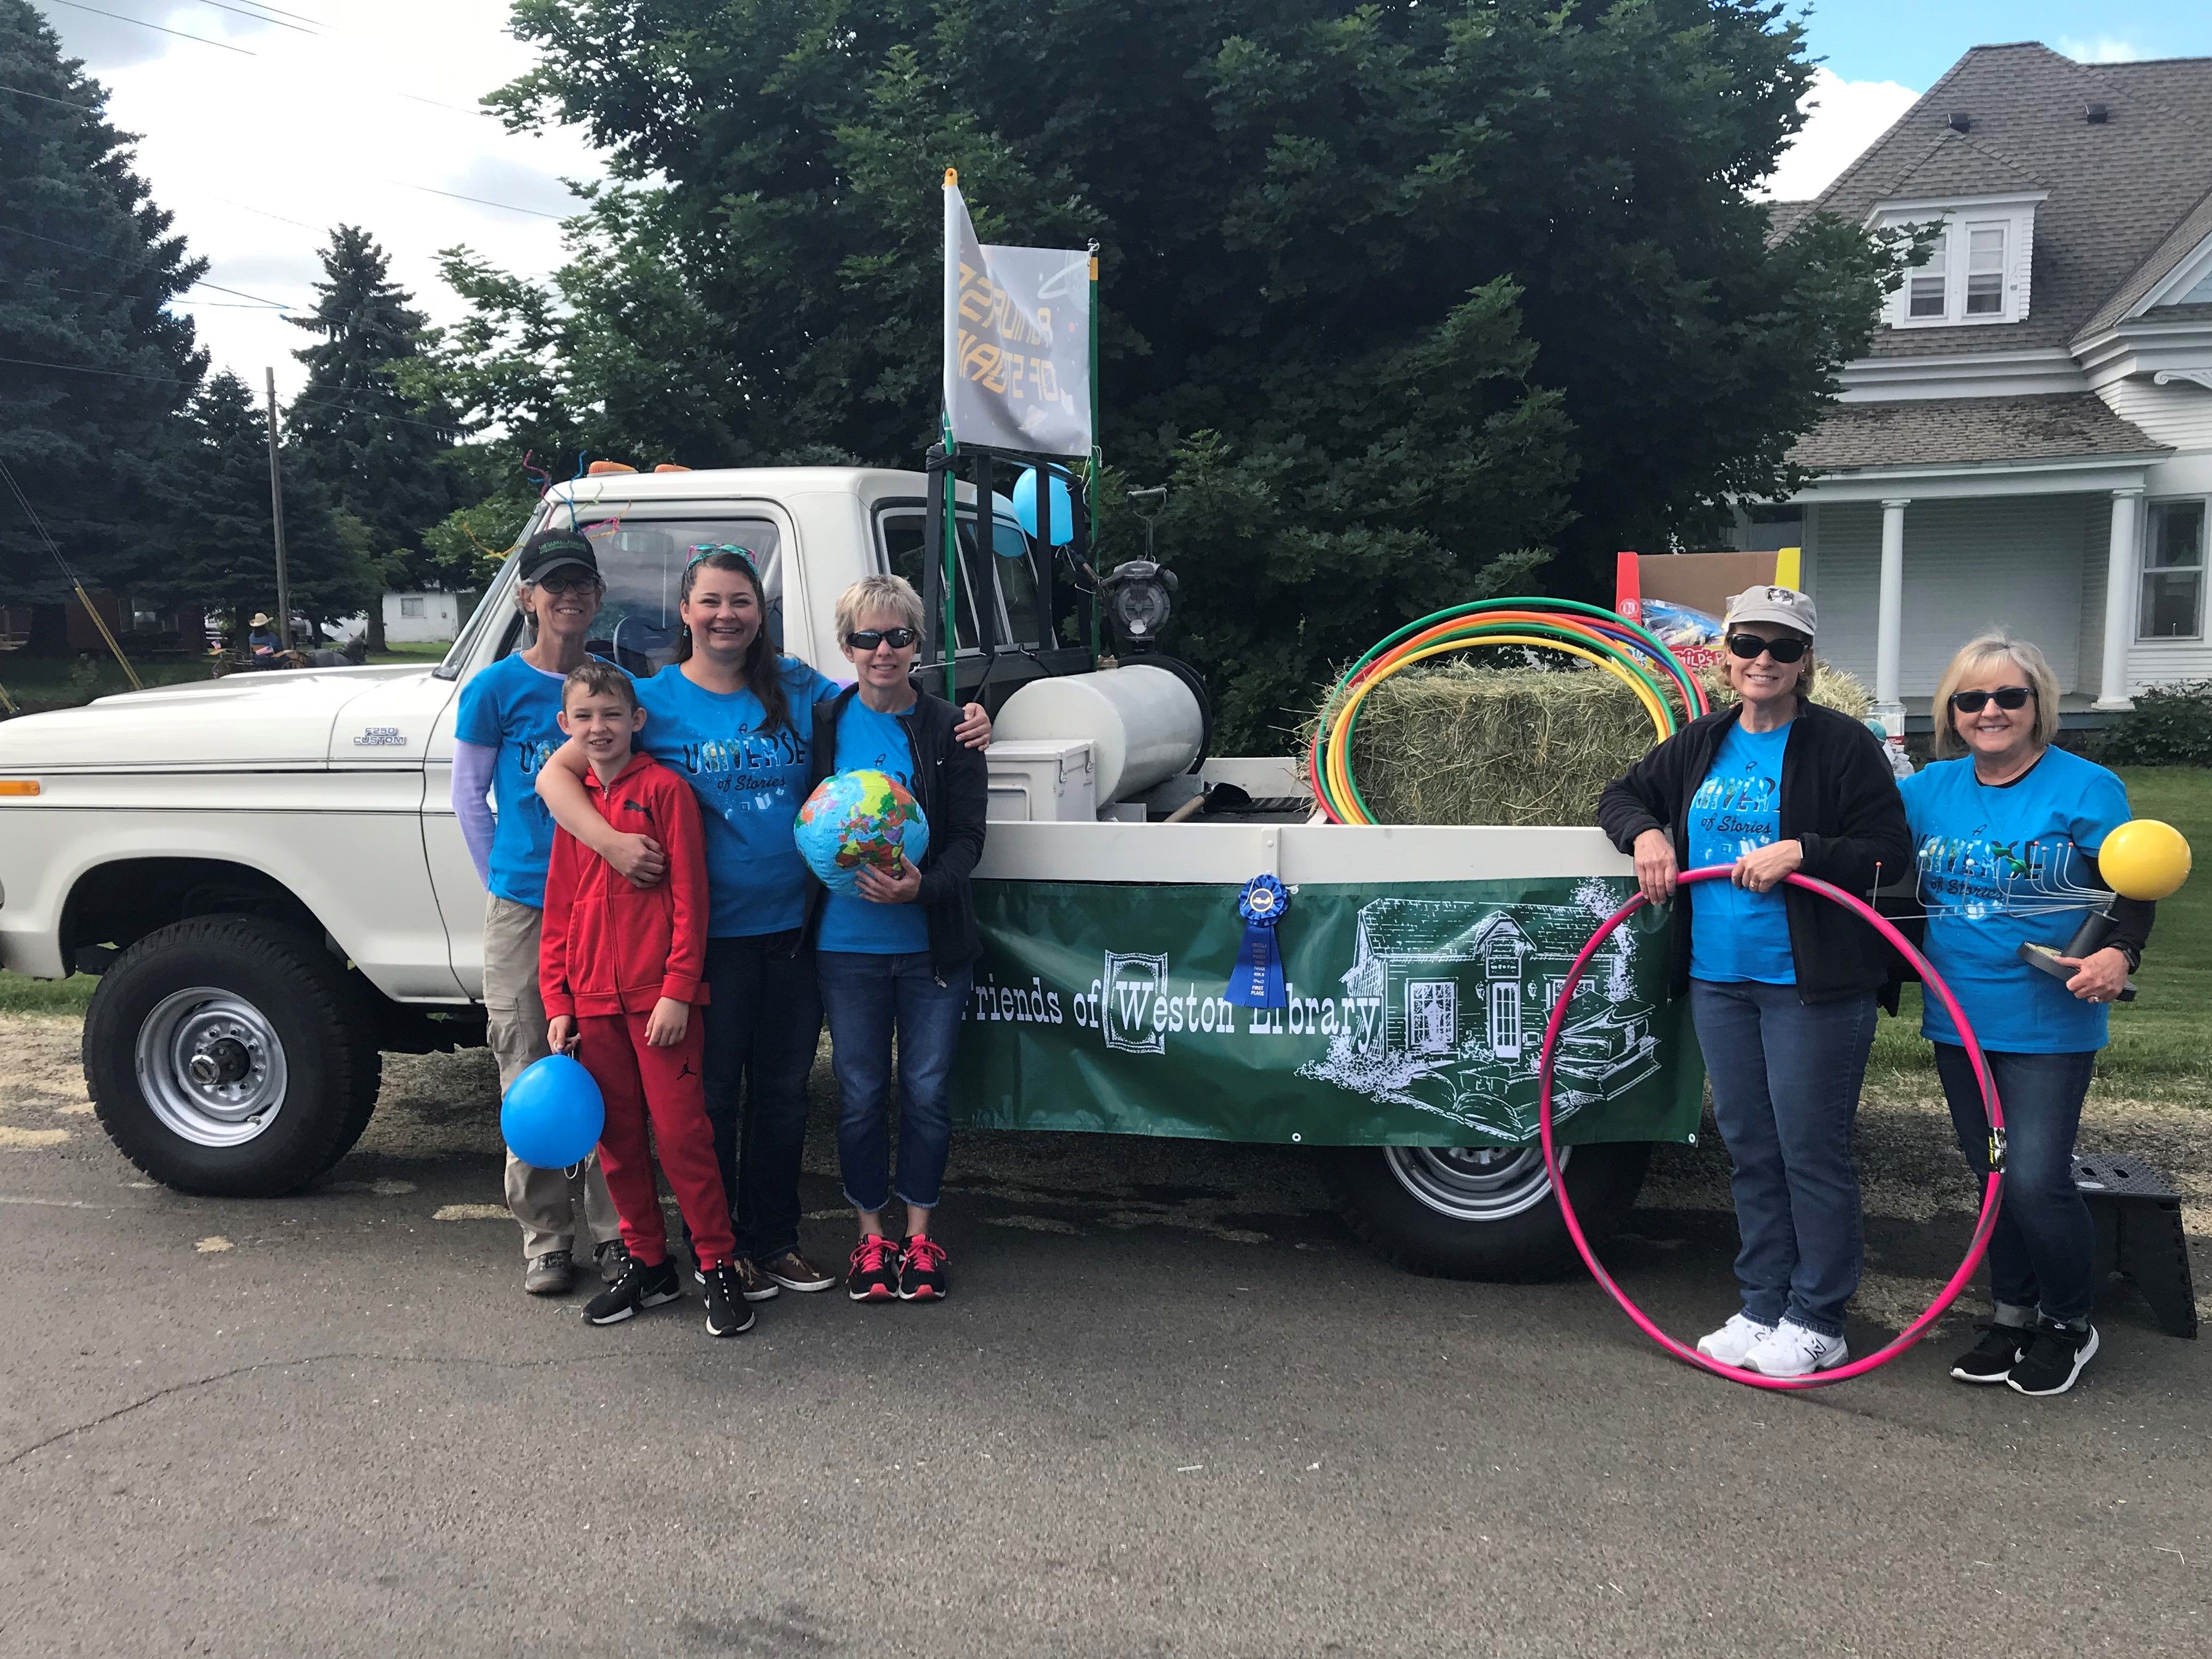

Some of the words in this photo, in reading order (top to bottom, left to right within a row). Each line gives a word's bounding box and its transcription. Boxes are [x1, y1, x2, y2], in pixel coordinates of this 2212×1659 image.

[353, 736, 405, 745] CUSTOM
[682, 731, 806, 776] UNIVERSE
[717, 774, 732, 793] of
[735, 774, 786, 791] Stories
[1701, 813, 1718, 832] of
[1717, 815, 1772, 834] Stories
[961, 973, 1063, 1024] riends
[1073, 979, 1102, 1028] of
[1115, 980, 1235, 1034] Weston
